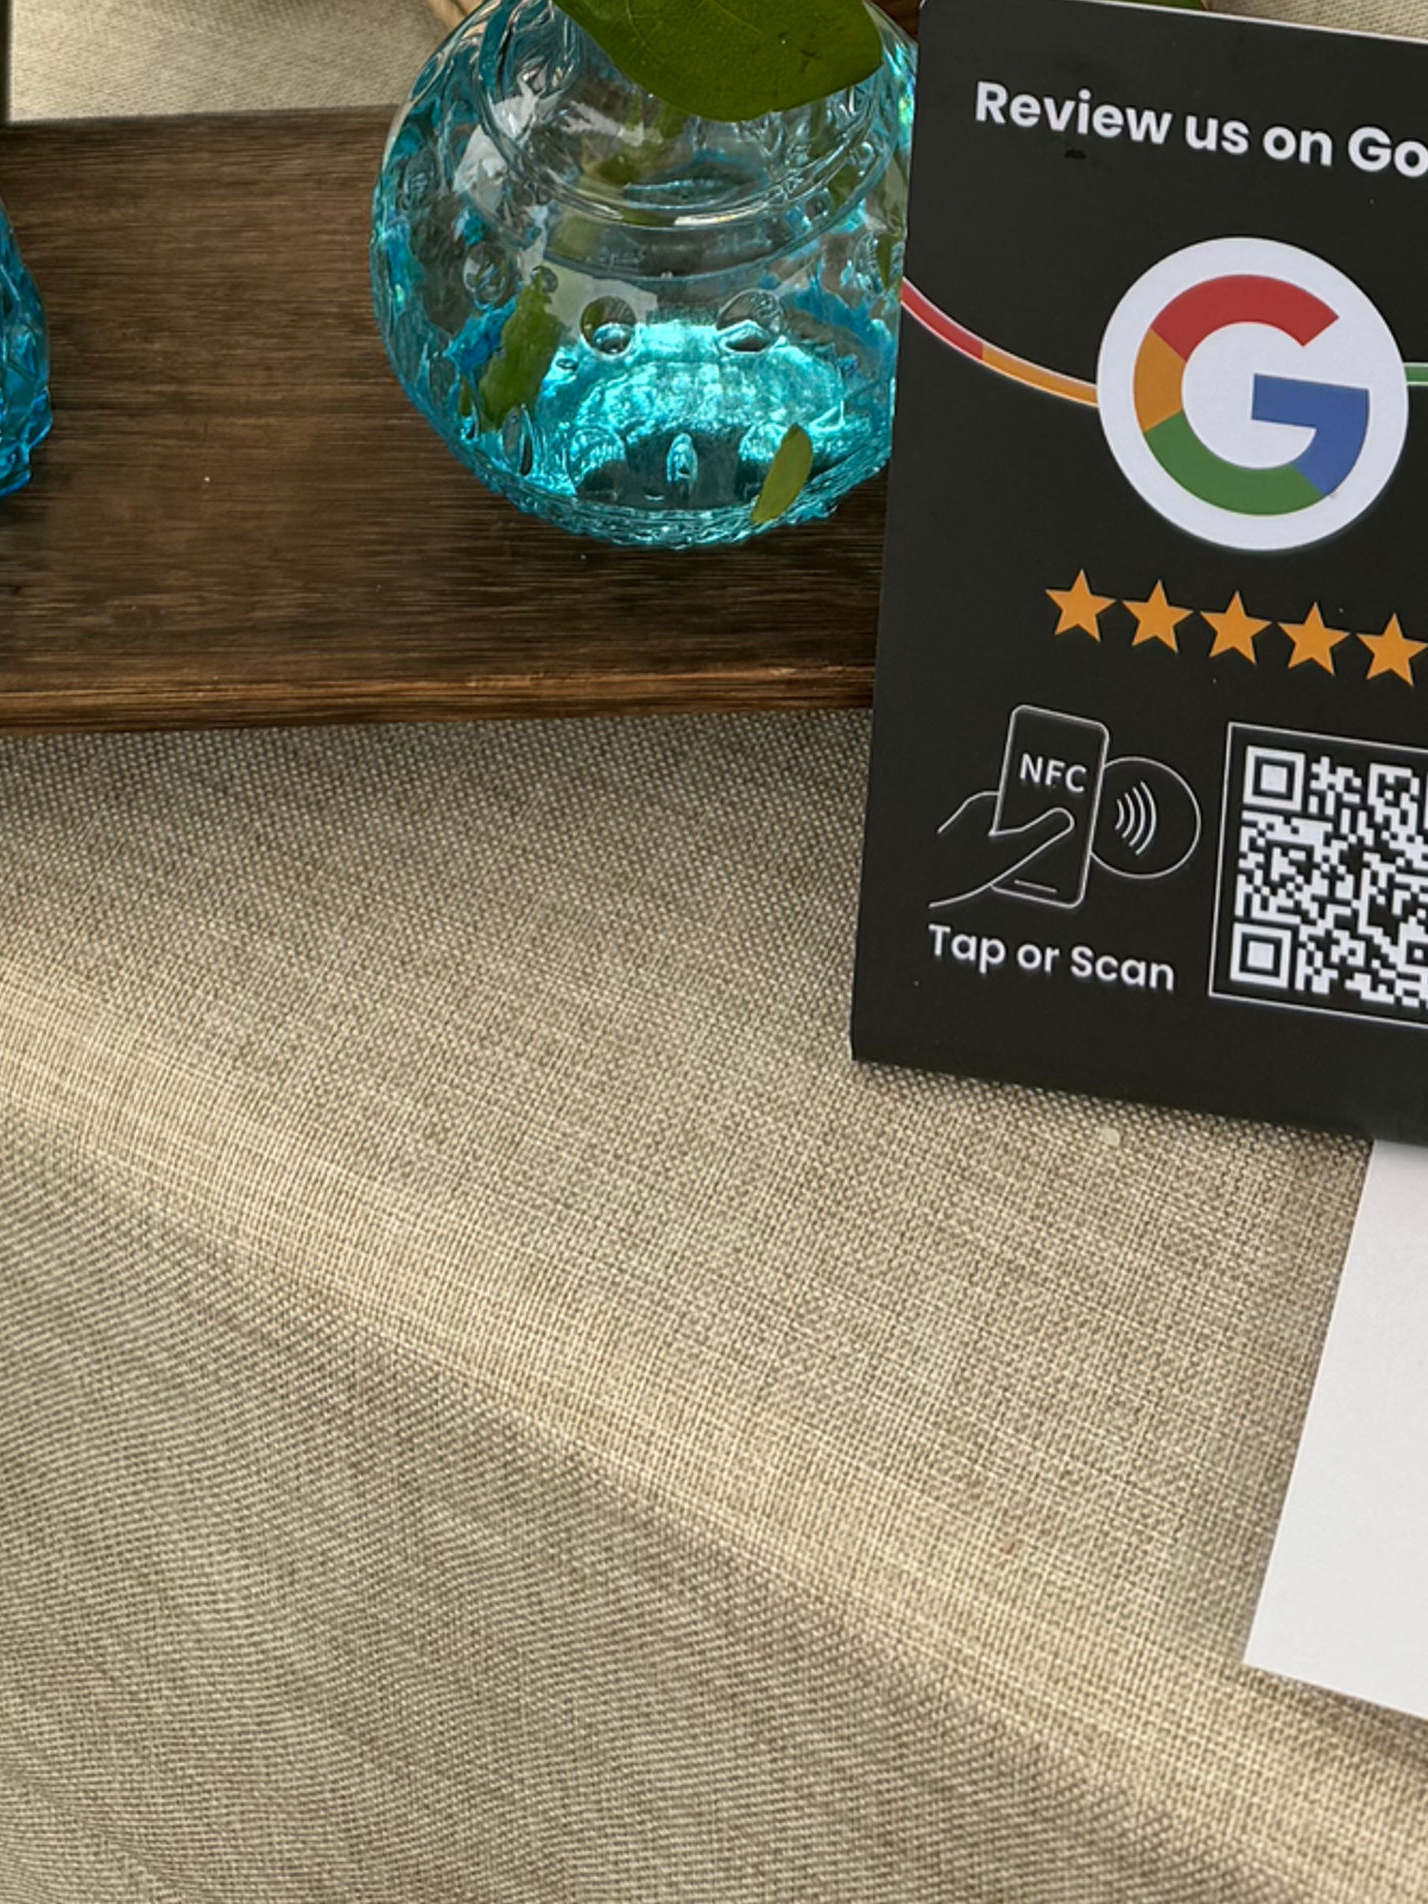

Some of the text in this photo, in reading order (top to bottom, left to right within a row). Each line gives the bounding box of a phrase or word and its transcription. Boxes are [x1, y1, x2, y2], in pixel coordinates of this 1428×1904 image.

[974, 80, 1174, 146] Review
[1184, 114, 1250, 156] us
[1262, 125, 1334, 168] on
[1132, 272, 1371, 518] G
[1018, 751, 1089, 795] NFC
[927, 922, 1176, 993] Tap or Scan
